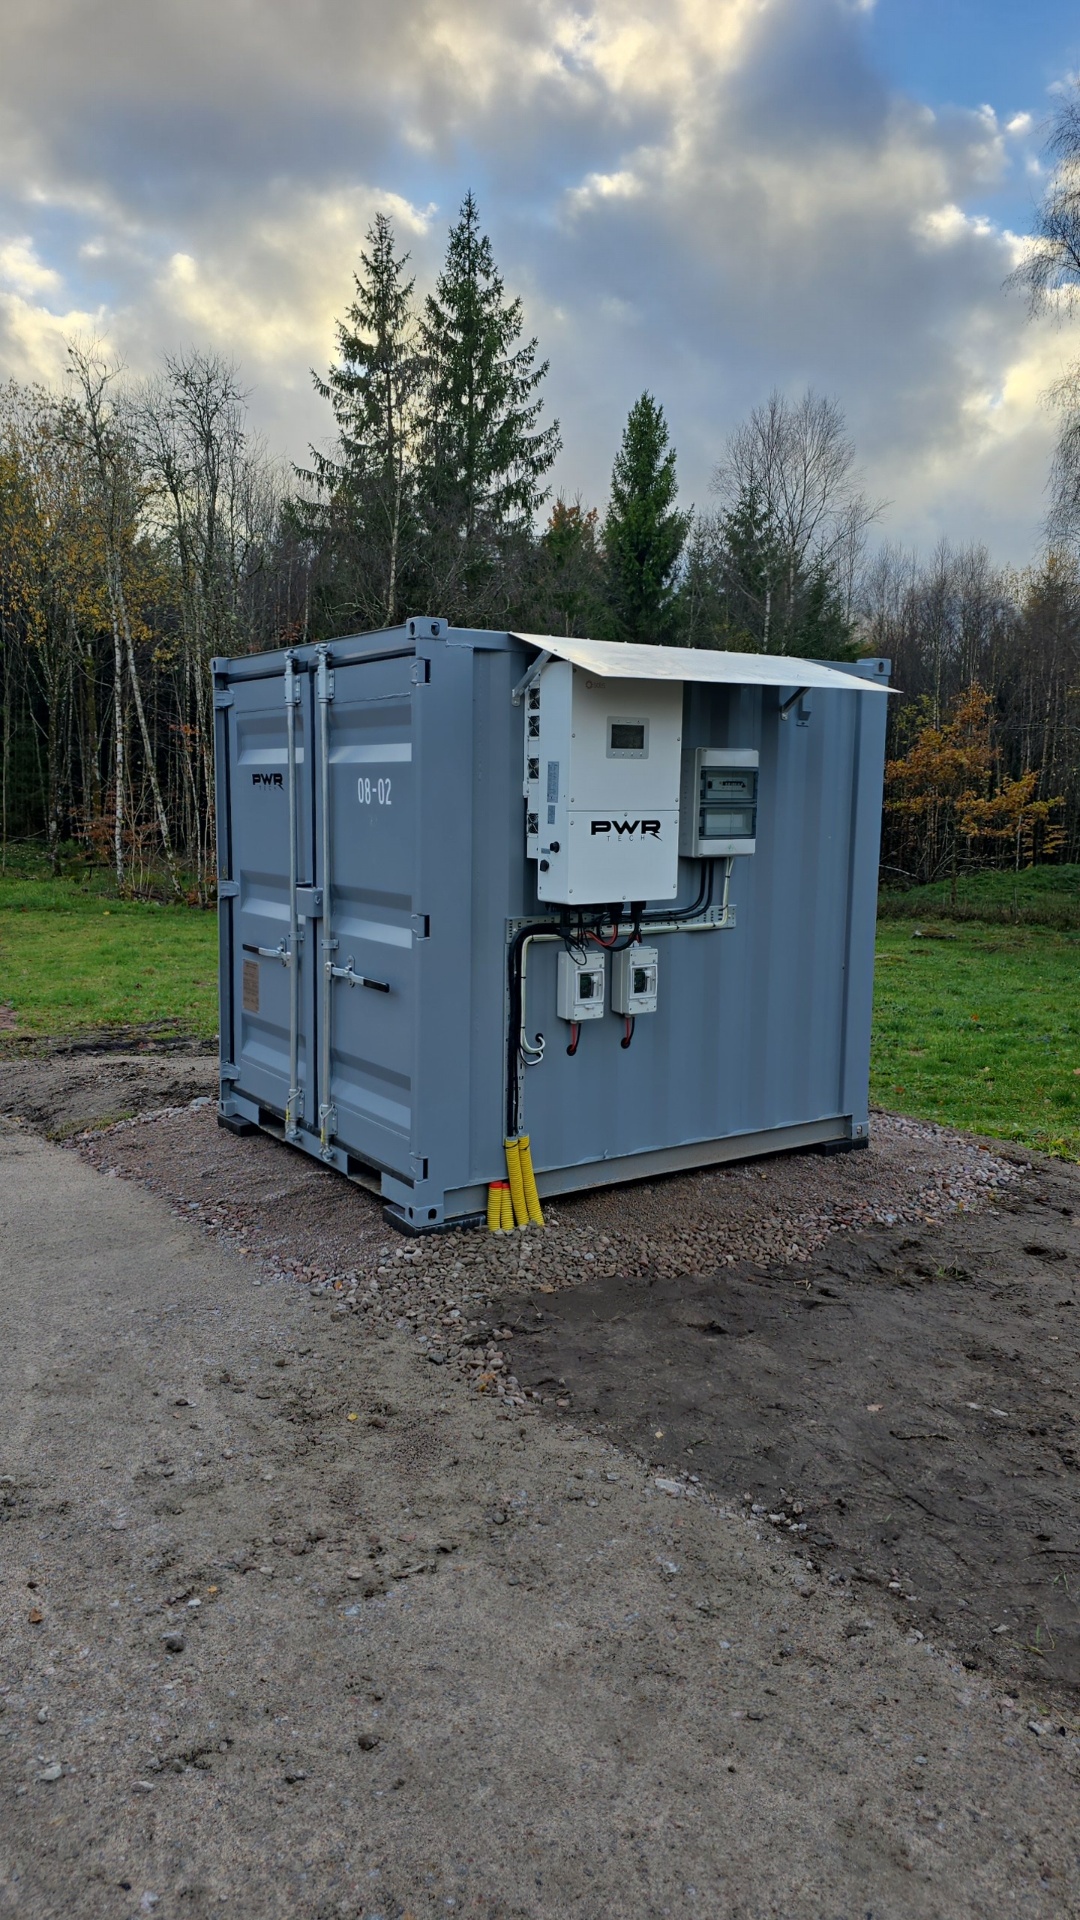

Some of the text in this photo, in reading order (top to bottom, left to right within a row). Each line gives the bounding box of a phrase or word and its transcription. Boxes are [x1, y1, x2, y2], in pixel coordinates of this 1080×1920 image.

[252, 773, 284, 791] PWR
[358, 778, 392, 805] 08-02
[591, 820, 662, 841] PWR
